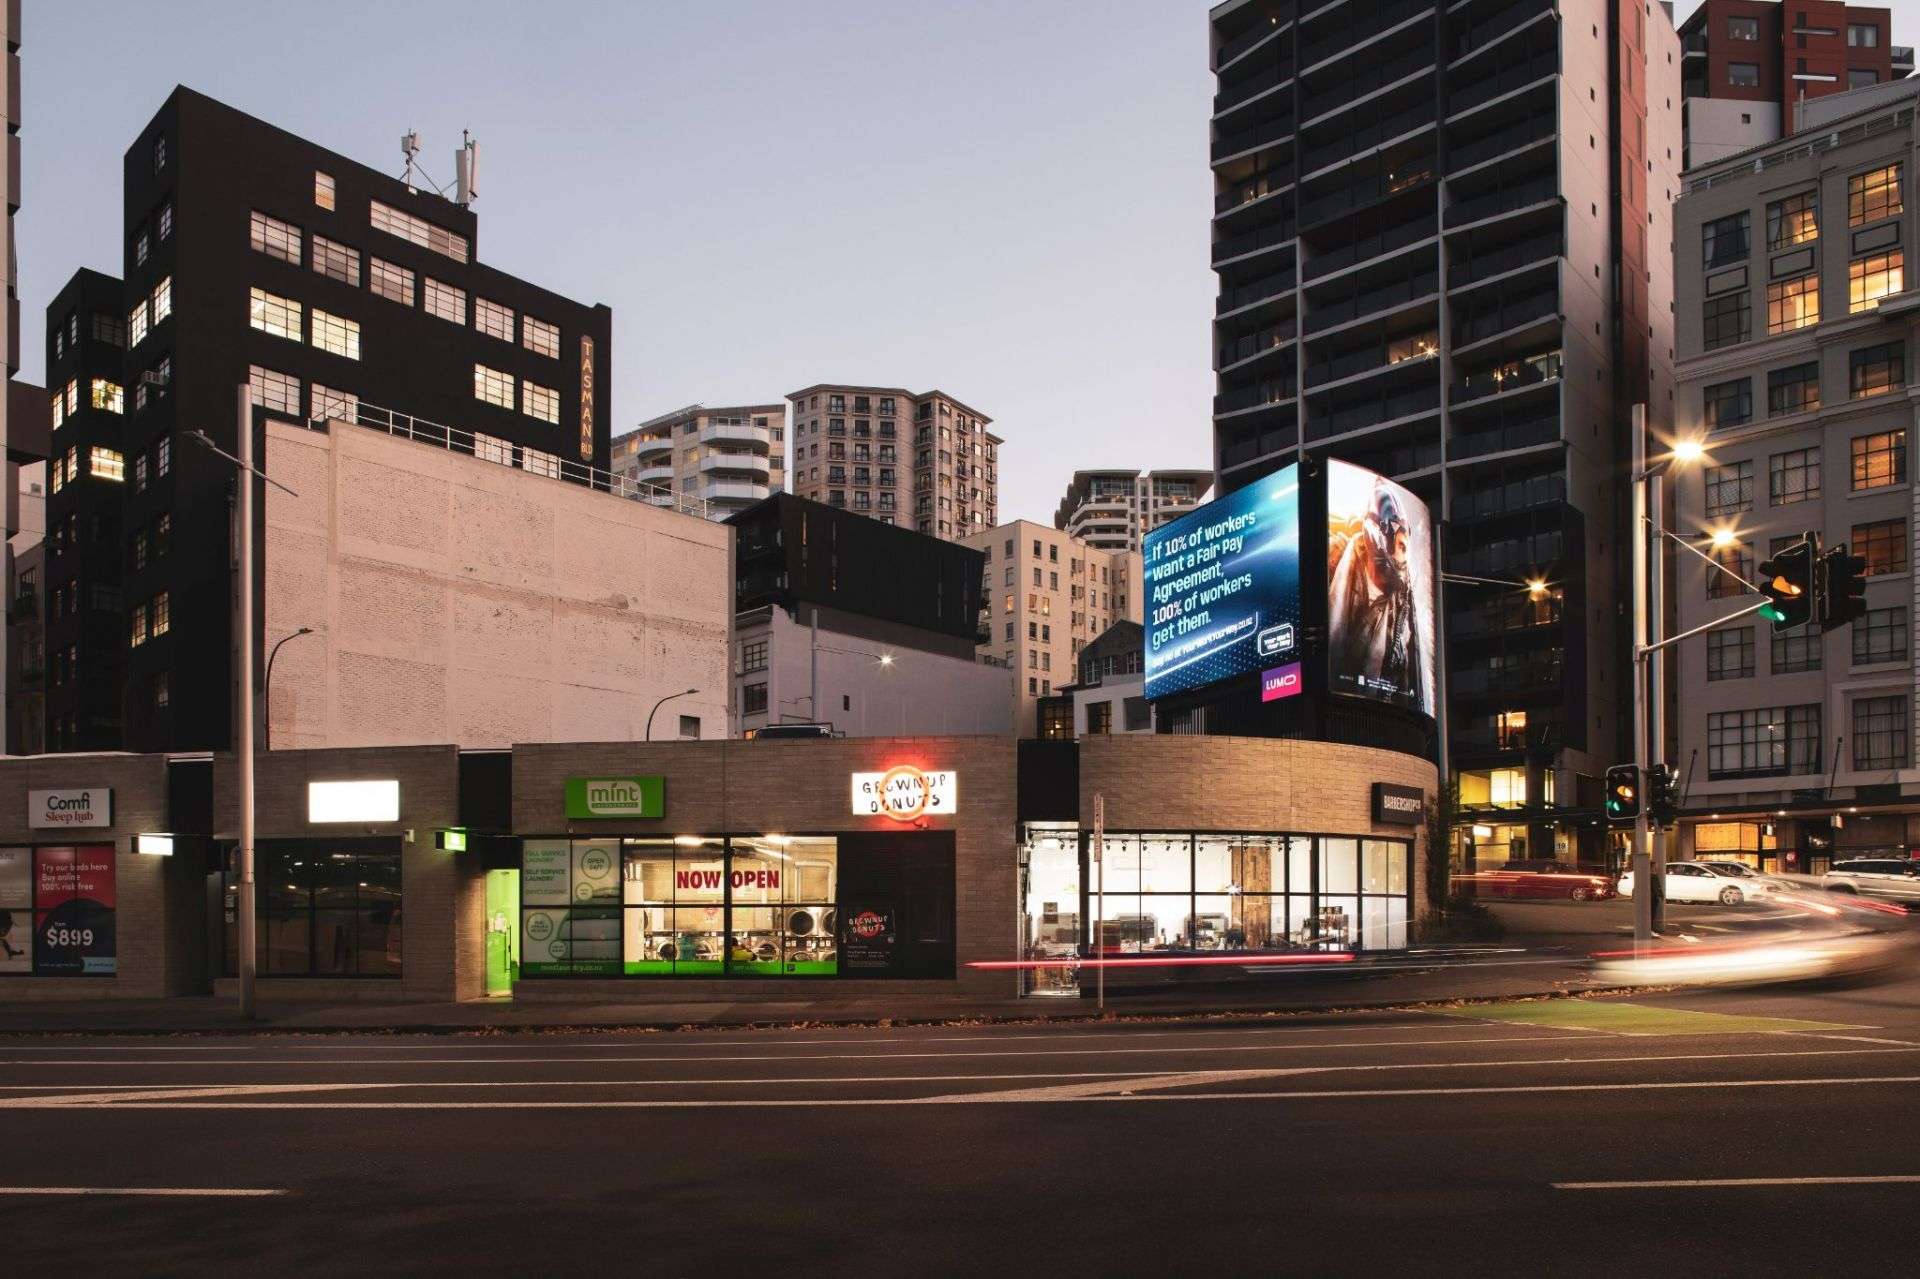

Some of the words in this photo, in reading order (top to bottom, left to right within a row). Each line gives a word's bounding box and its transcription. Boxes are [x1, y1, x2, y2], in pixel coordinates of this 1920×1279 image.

[582, 342, 593, 440] TASMAN
[1165, 534, 1187, 556] 10%
[1188, 526, 1203, 547] of
[1204, 511, 1256, 541] workers
[1152, 555, 1185, 581] want
[1187, 553, 1195, 568] a
[1196, 543, 1221, 564] Fair
[1152, 561, 1224, 603] Agreement,
[1152, 600, 1183, 626] 100%
[1184, 591, 1198, 612] of
[1200, 573, 1252, 605] workers
[1152, 622, 1175, 651] get
[1177, 611, 1212, 635] them.
[1266, 674, 1296, 691] LUMO
[47, 792, 90, 810] Comfi
[591, 782, 639, 802] mint
[46, 811, 73, 824] Sleep
[74, 811, 94, 823] hub
[42, 863, 54, 873] Try
[90, 863, 108, 871] here
[587, 857, 605, 865] OPEN
[42, 873, 55, 883] Buy
[42, 883, 60, 891] 100%
[676, 870, 721, 889] NOW
[730, 870, 780, 889] OPEN
[47, 925, 93, 949] $899
